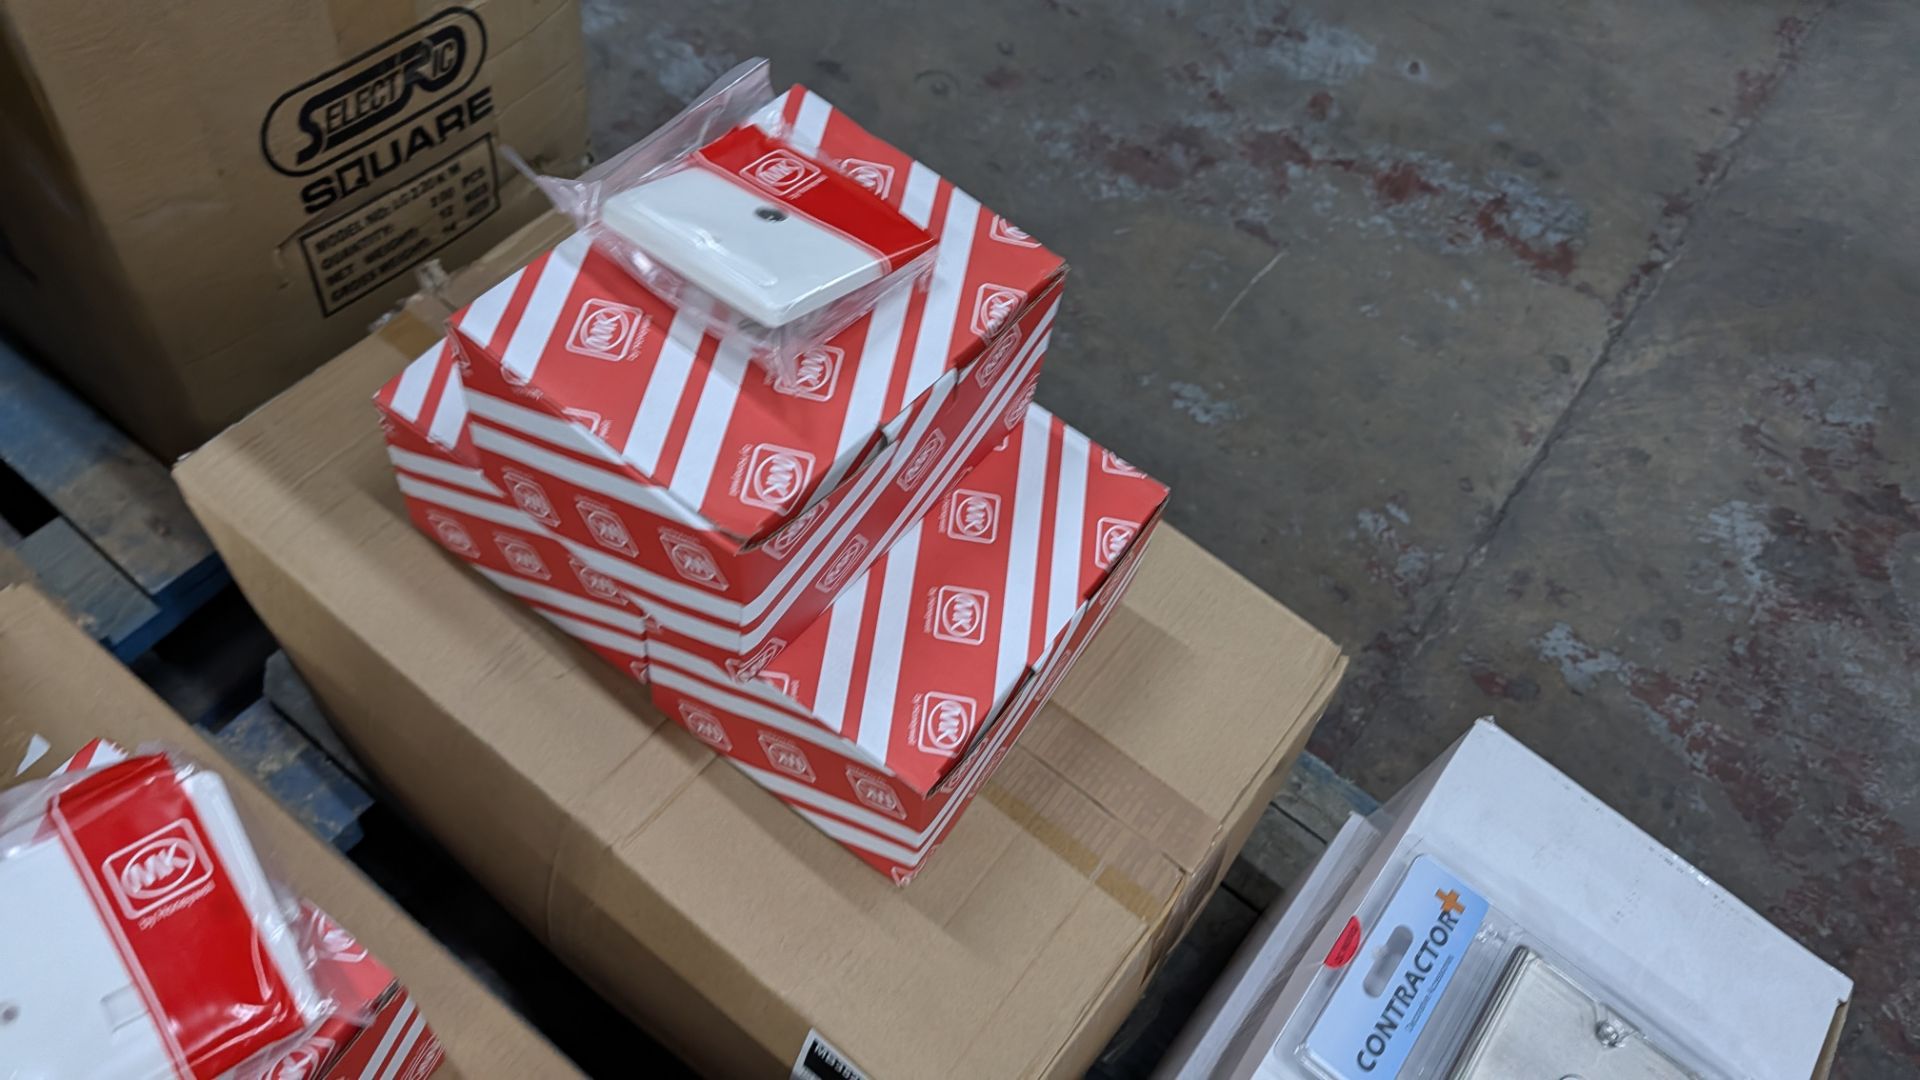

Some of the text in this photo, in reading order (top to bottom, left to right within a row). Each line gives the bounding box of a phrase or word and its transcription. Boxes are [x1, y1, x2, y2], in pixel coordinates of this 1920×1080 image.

[297, 25, 466, 166] SELECTRIC
[301, 85, 494, 214] SQUARE
[761, 453, 797, 498] MK
[934, 700, 962, 745] MK
[128, 842, 190, 894] MK
